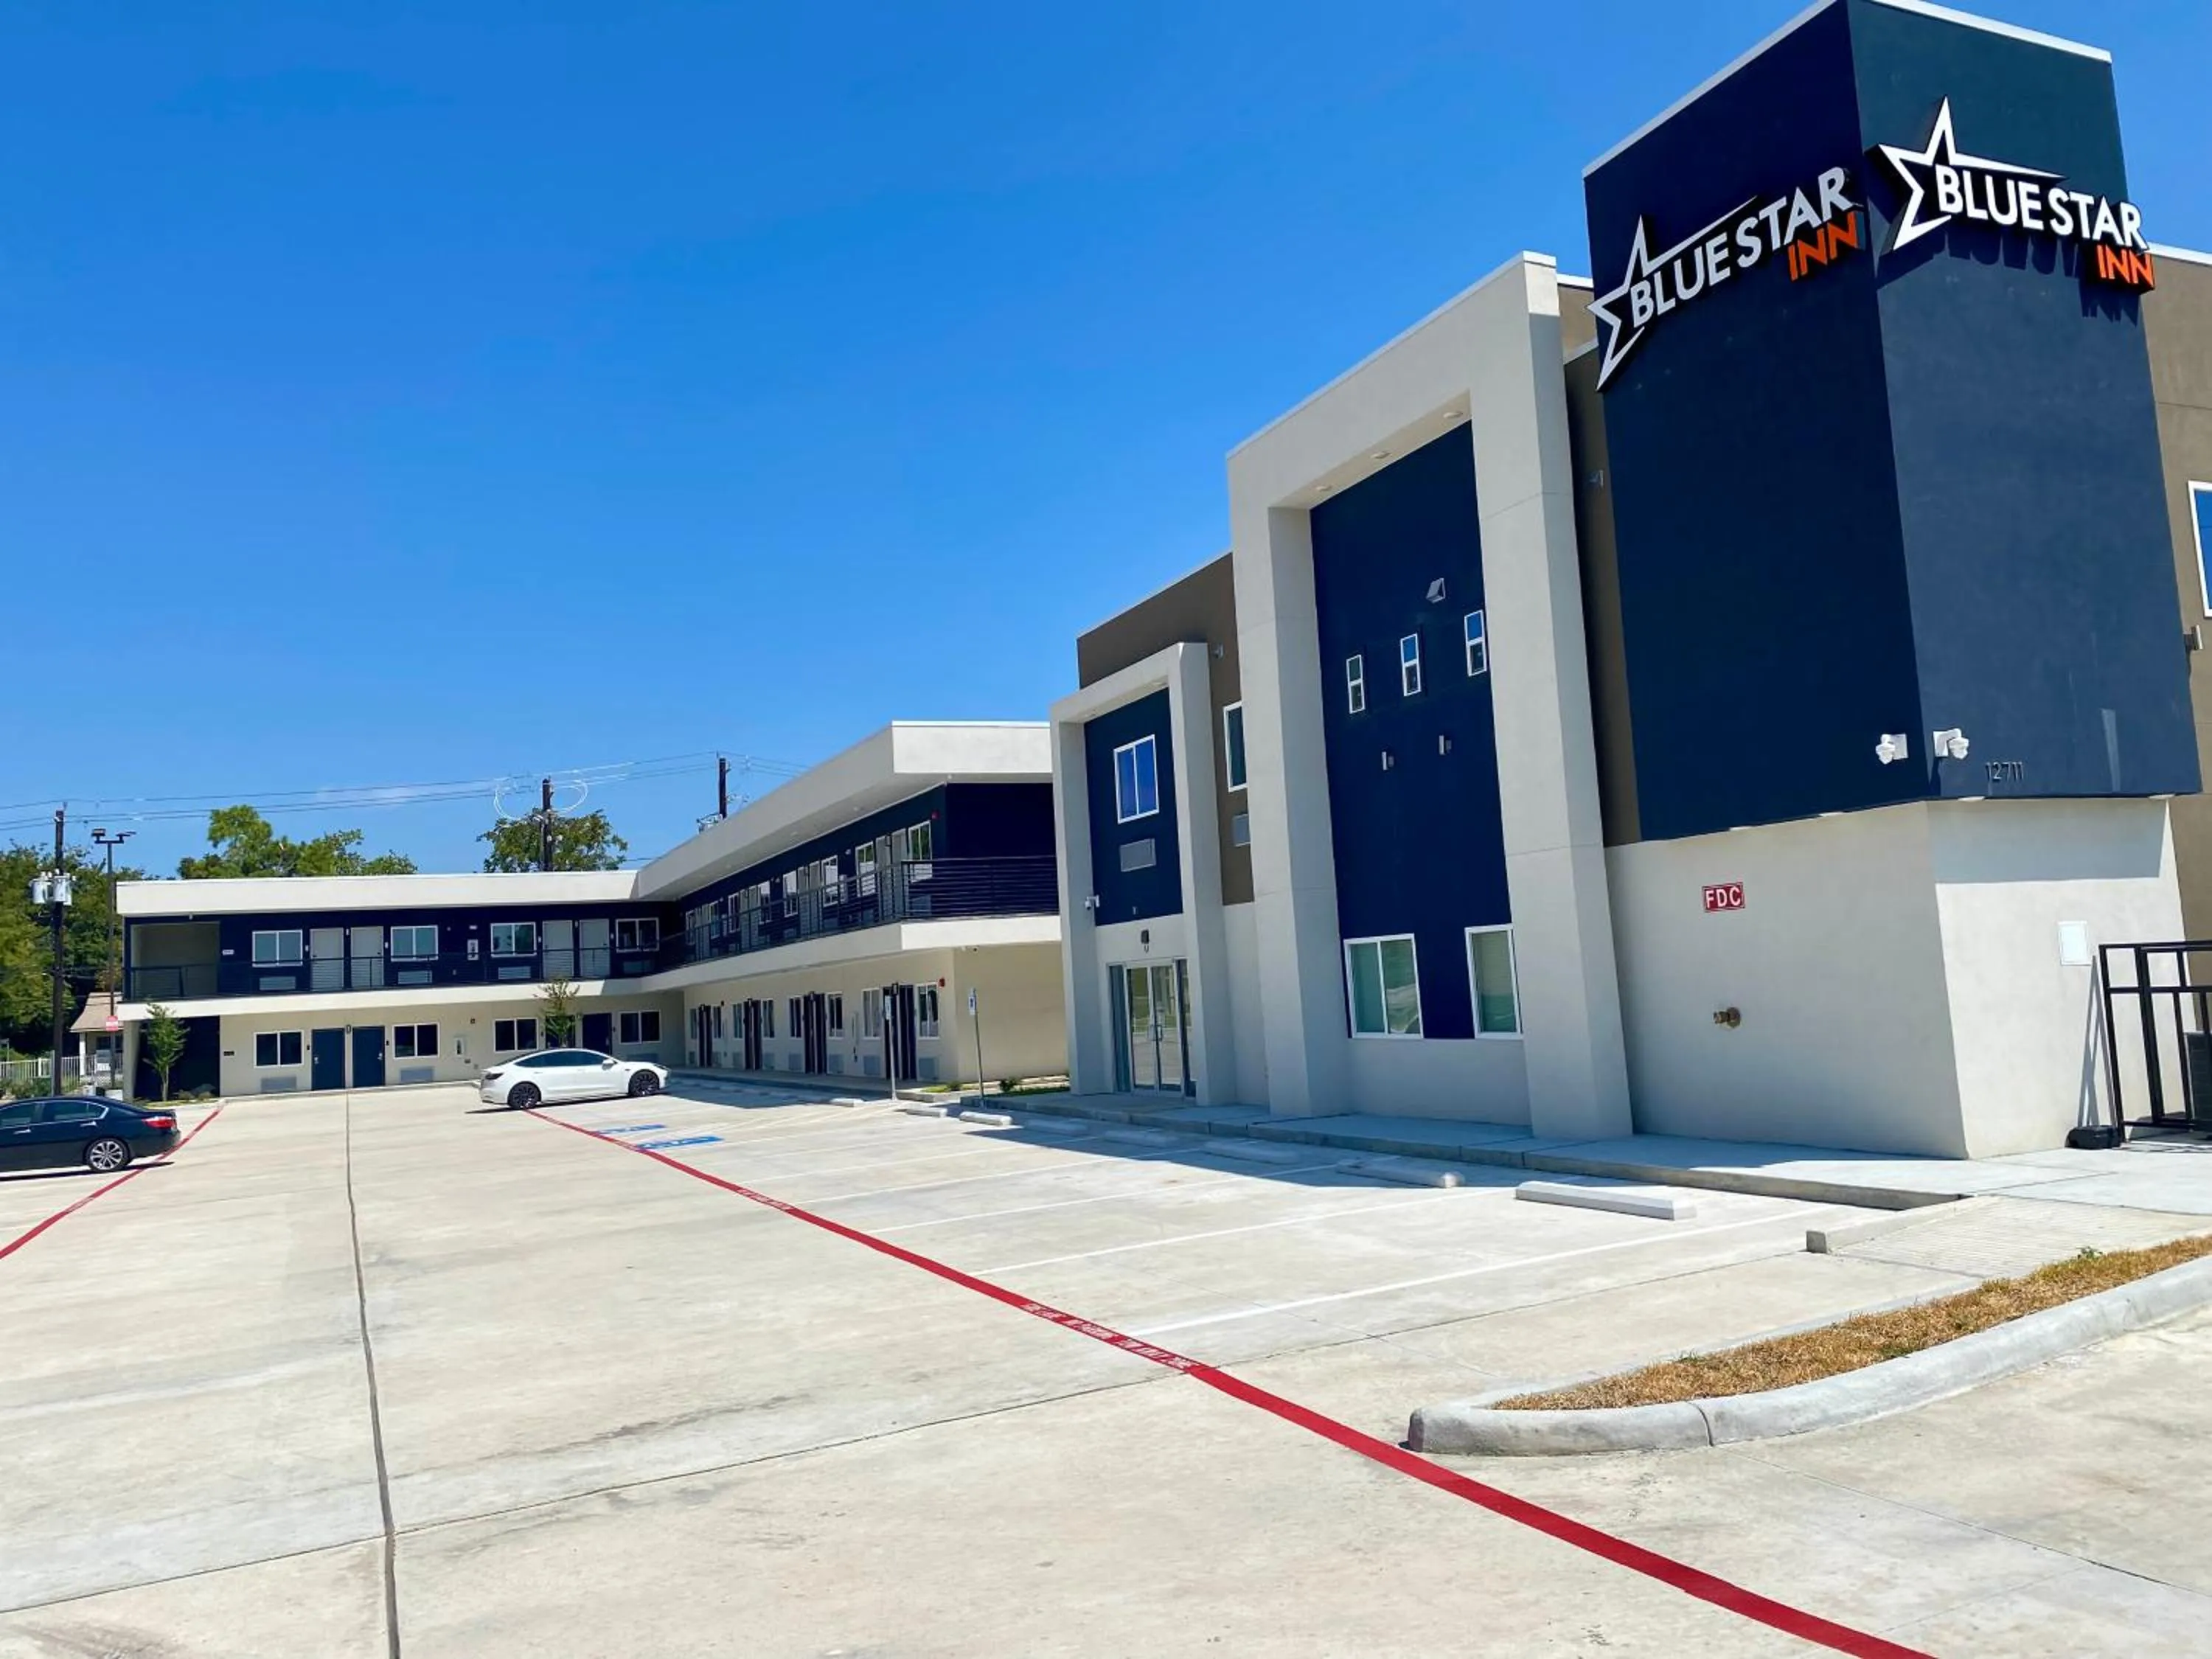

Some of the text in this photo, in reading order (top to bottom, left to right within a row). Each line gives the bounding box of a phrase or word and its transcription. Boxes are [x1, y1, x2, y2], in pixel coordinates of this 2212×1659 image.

[1787, 211, 1859, 282] INN
[2096, 244, 2154, 288] INN
[1985, 761, 2024, 781] 12711
[1705, 886, 1742, 908] FDC
